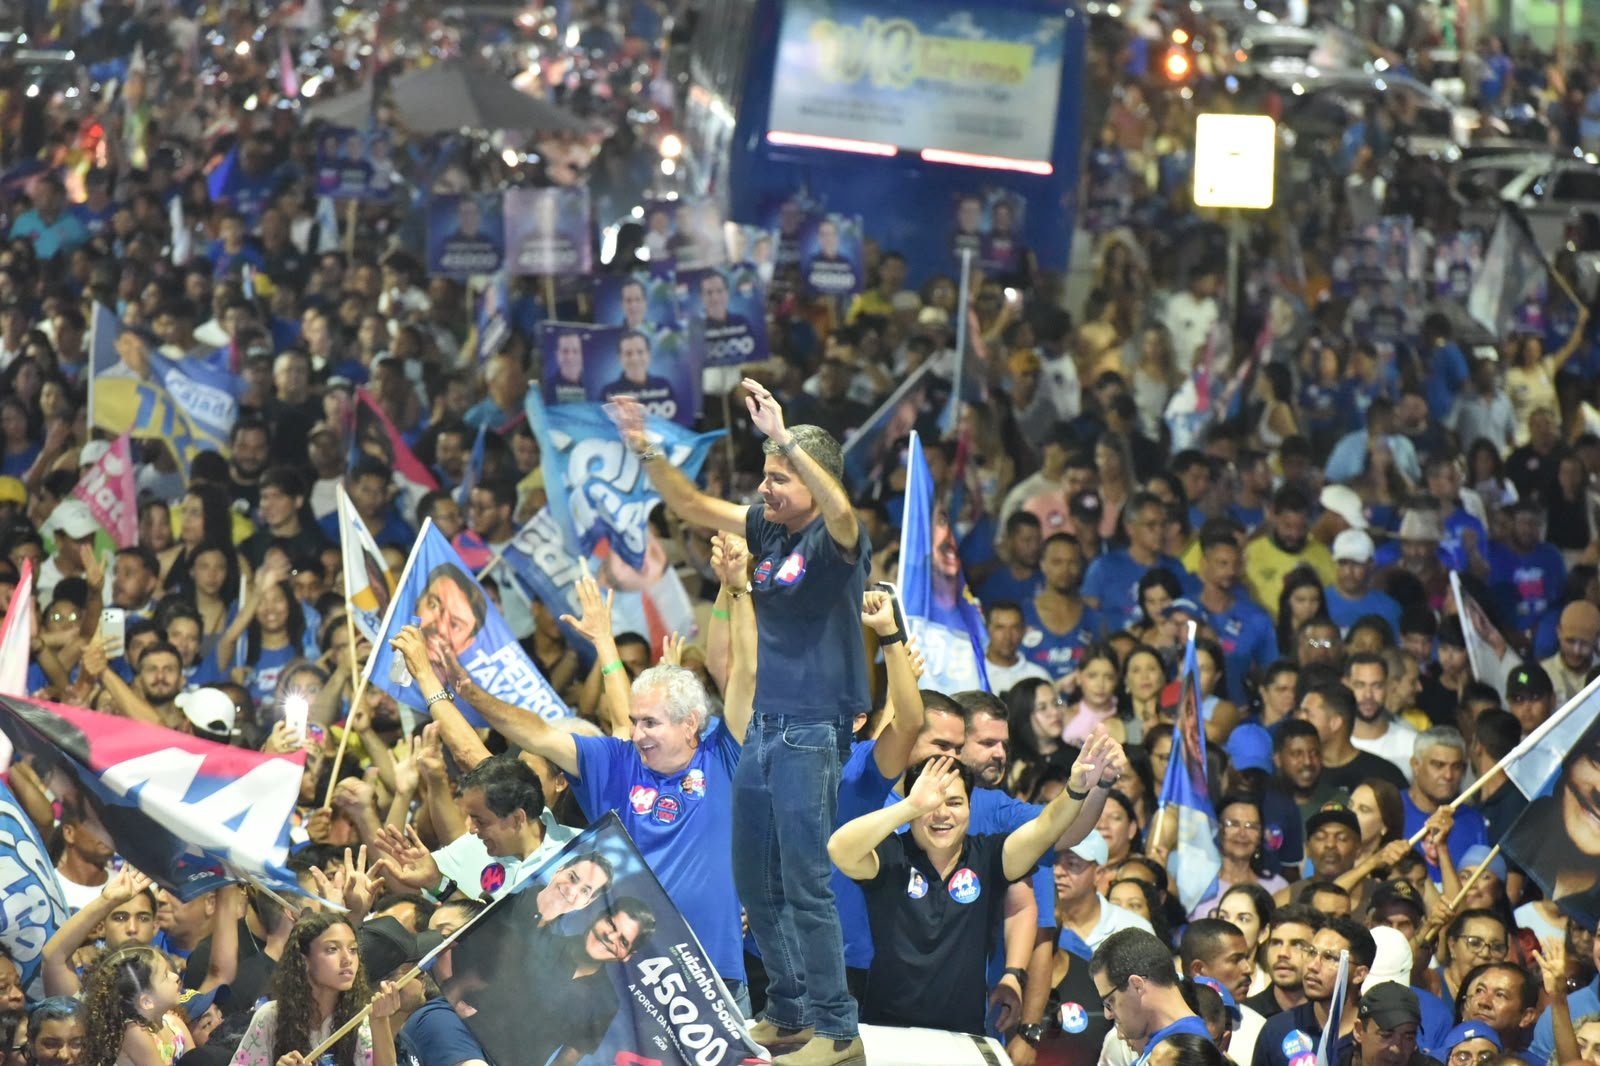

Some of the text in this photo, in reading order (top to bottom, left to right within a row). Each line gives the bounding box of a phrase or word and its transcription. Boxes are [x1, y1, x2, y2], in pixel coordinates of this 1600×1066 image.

[465, 649, 535, 712] TAVA
[489, 644, 564, 721] PEDRO
[952, 870, 974, 891] 44
[675, 943, 717, 1000] Luizinho
[628, 984, 636, 992] A
[634, 989, 658, 1018] FORÇA
[656, 1014, 667, 1028] DA
[637, 957, 728, 1066] 45000
